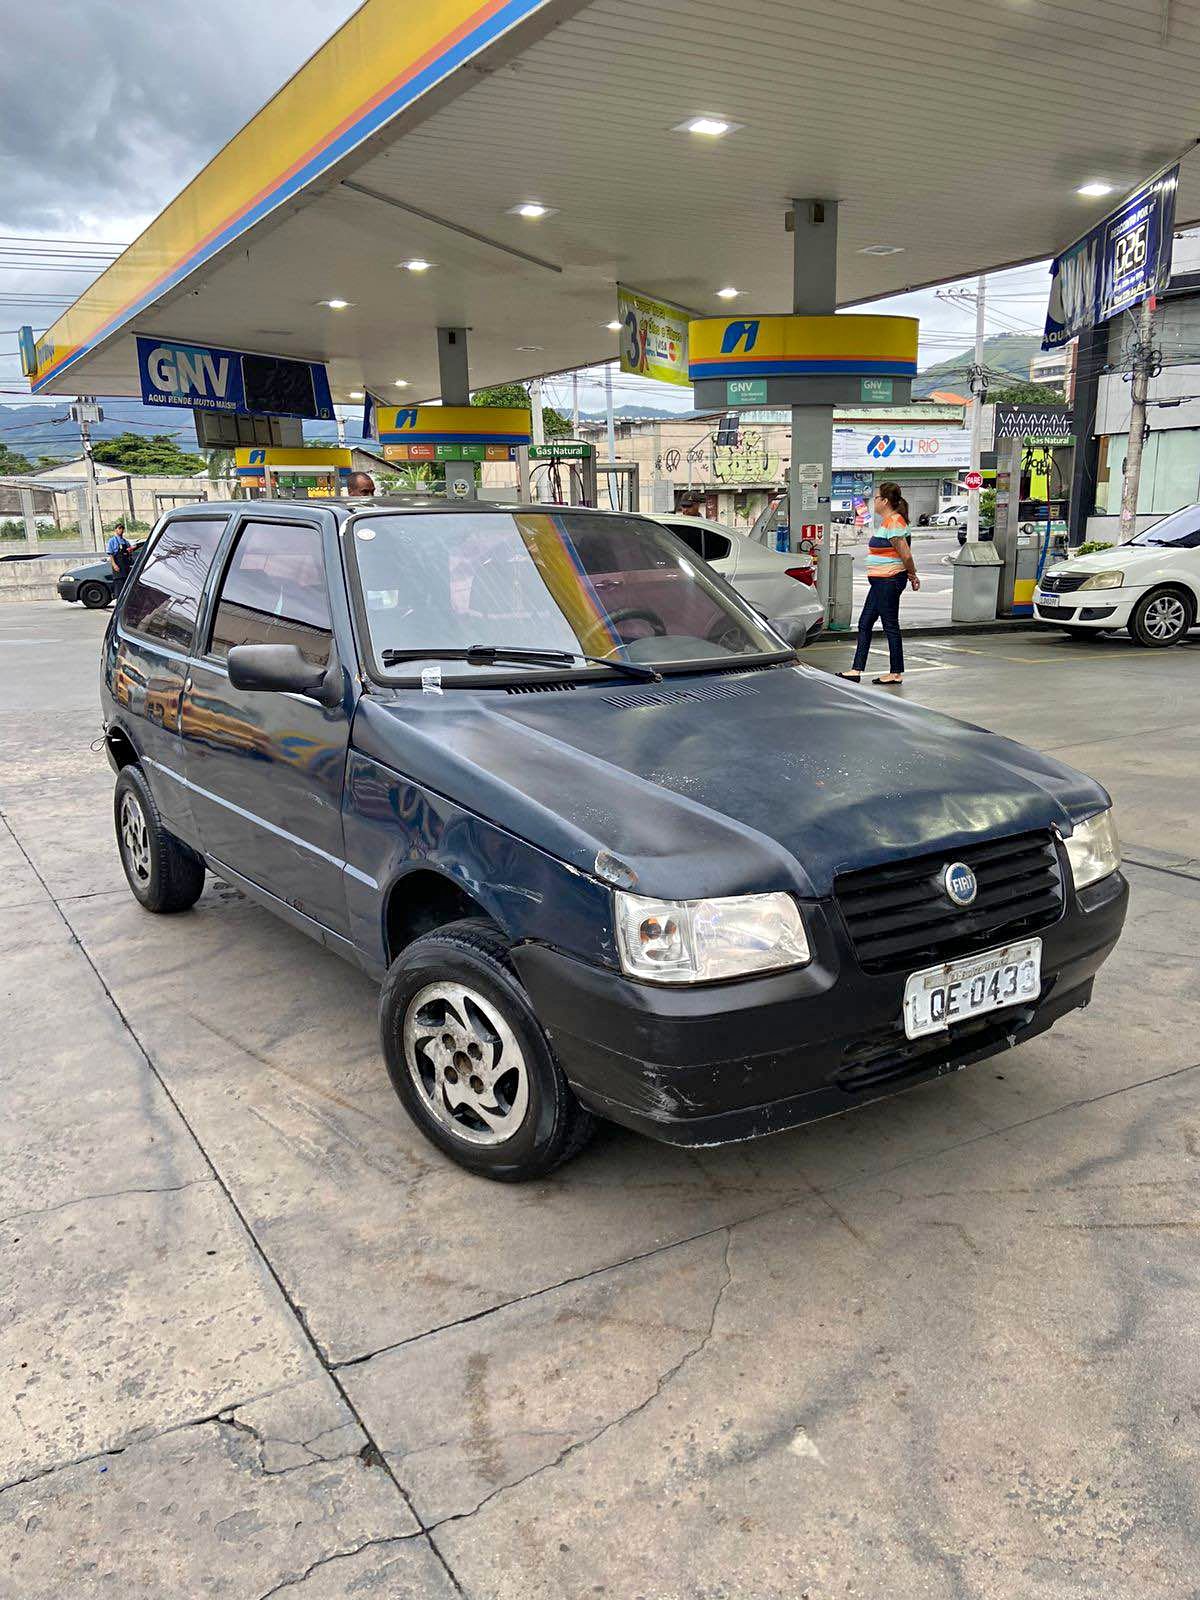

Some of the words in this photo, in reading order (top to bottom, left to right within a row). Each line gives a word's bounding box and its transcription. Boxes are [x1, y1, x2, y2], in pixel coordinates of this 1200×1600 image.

[147, 347, 229, 398] GNV
[730, 382, 753, 393] GNV
[863, 380, 882, 390] GNV
[148, 393, 167, 404] AQUI
[168, 394, 192, 405] RENDE
[1044, 436, 1070, 445] Natural
[553, 446, 583, 455] Natural
[899, 440, 914, 453] JJ
[966, 476, 981, 485] PARE
[952, 875, 973, 893] FIAT
